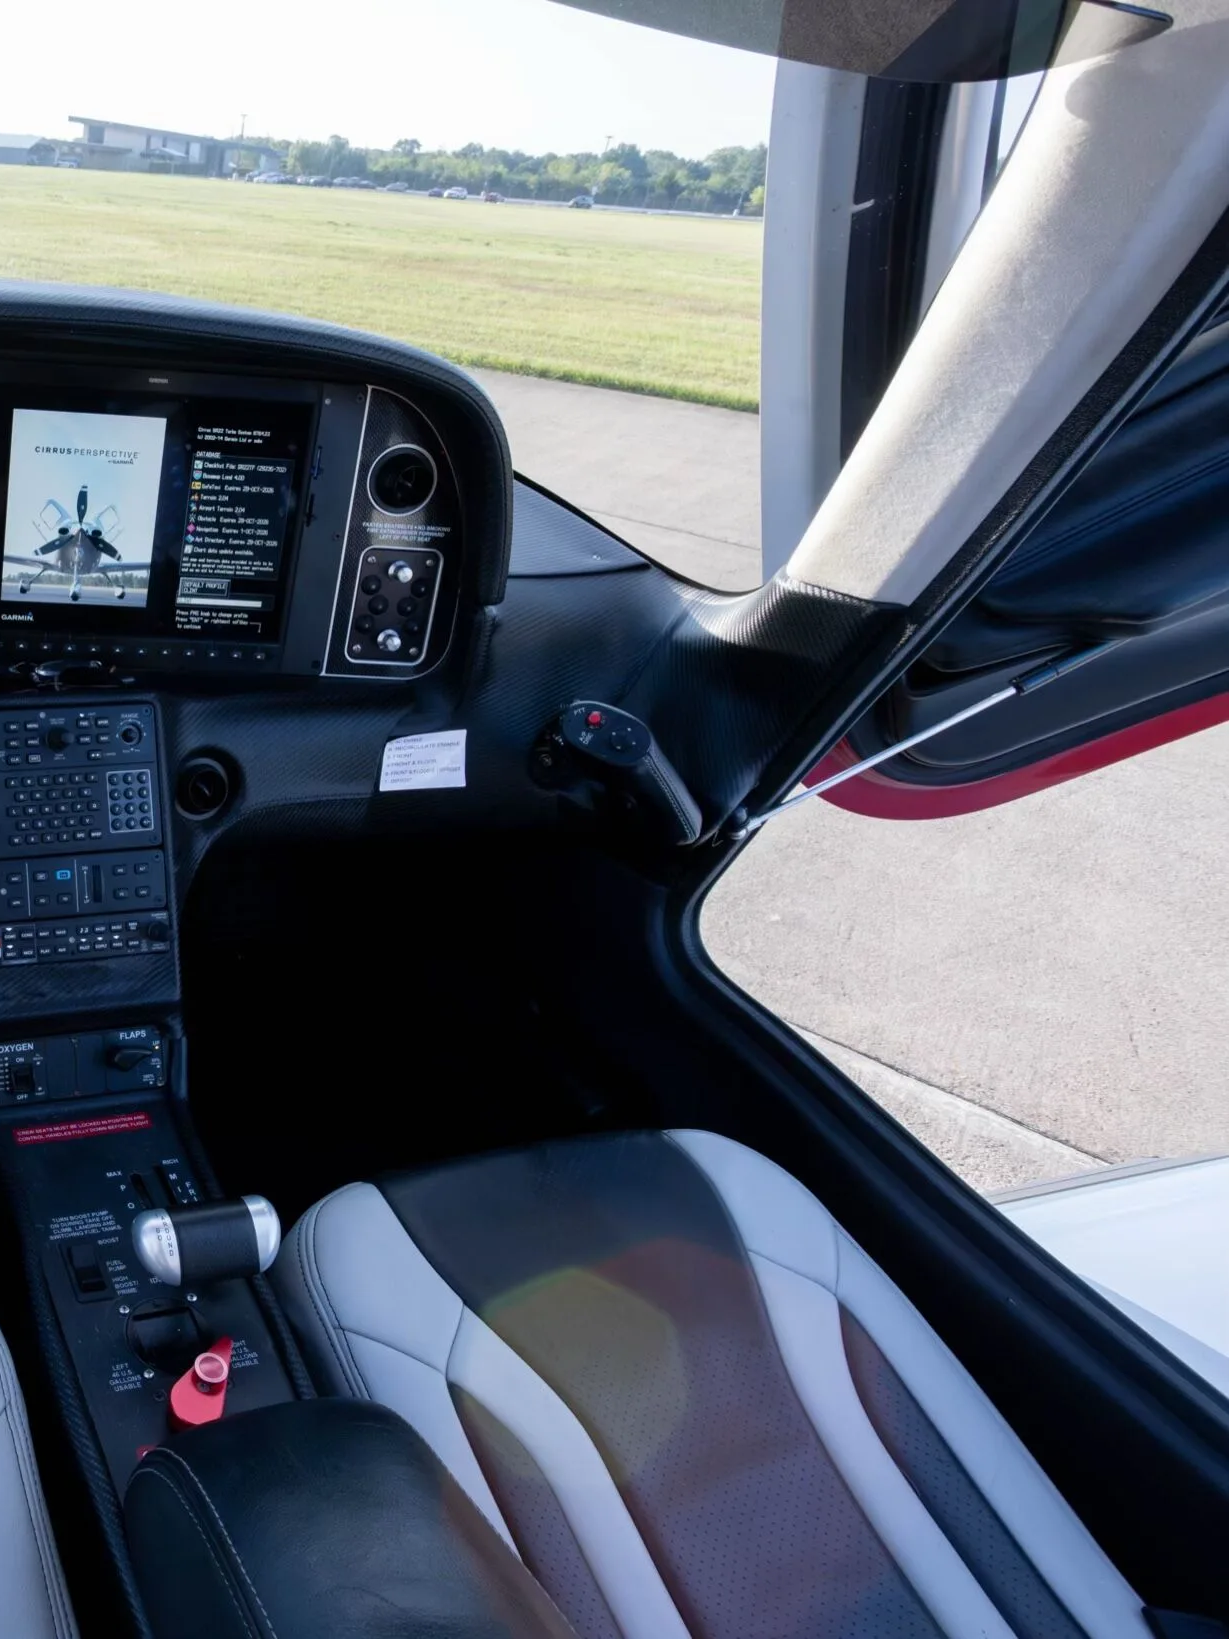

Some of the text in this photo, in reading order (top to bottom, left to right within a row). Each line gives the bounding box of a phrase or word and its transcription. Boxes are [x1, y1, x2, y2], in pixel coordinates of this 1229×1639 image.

[34, 446, 139, 459] CIRRUS PERSPECTIVE
[119, 1029, 146, 1040] FLAPS
[69, 1213, 90, 1221] BOOST
[74, 1223, 101, 1231] LANDING
[97, 1237, 119, 1245] BOOST
[112, 1275, 129, 1283] HIGH
[112, 1362, 129, 1371] LEFT
[109, 1375, 142, 1386] GALLONS
[115, 1382, 142, 1392] USABLE
